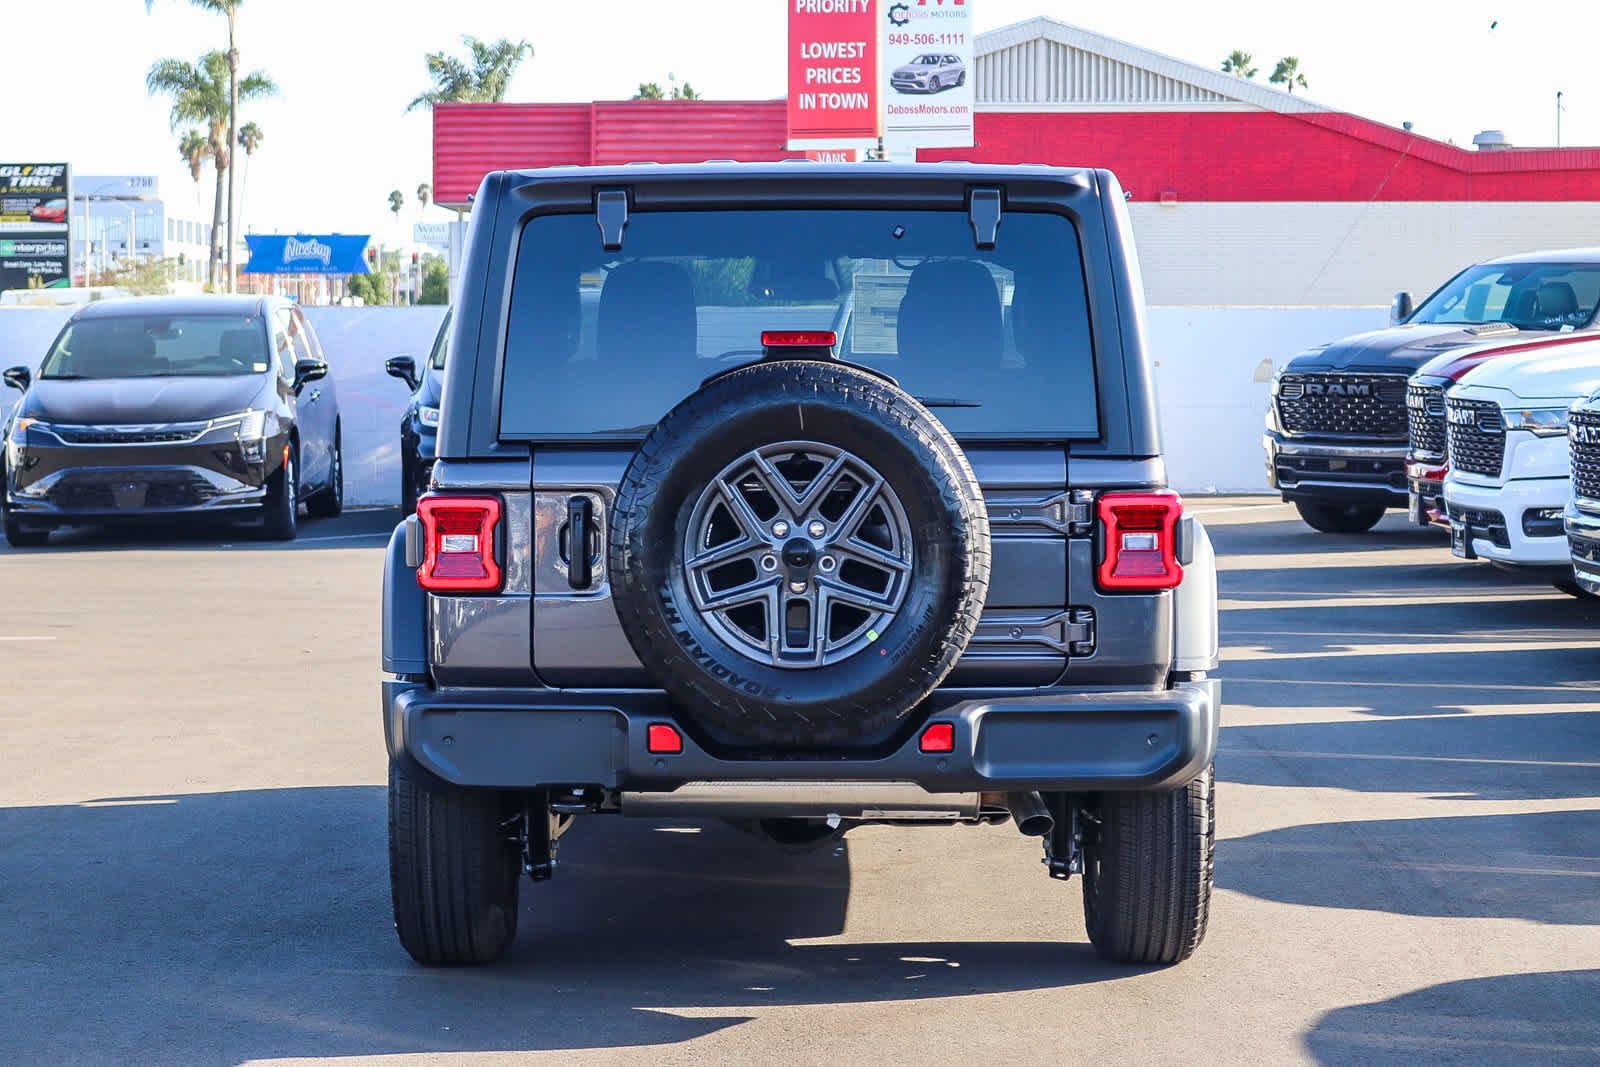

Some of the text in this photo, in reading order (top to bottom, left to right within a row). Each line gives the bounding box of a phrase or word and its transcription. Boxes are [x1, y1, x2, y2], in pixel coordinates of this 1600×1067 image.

[796, 0, 870, 13] PRIORITY
[930, 10, 967, 18] MOTORS
[888, 33, 965, 45] 949-506-1111
[801, 42, 867, 59] LOWEST
[806, 67, 861, 84] PRICES
[799, 93, 869, 110] IN TOWN
[887, 104, 968, 114] DebossMotors.com
[1305, 383, 1369, 395] RAM
